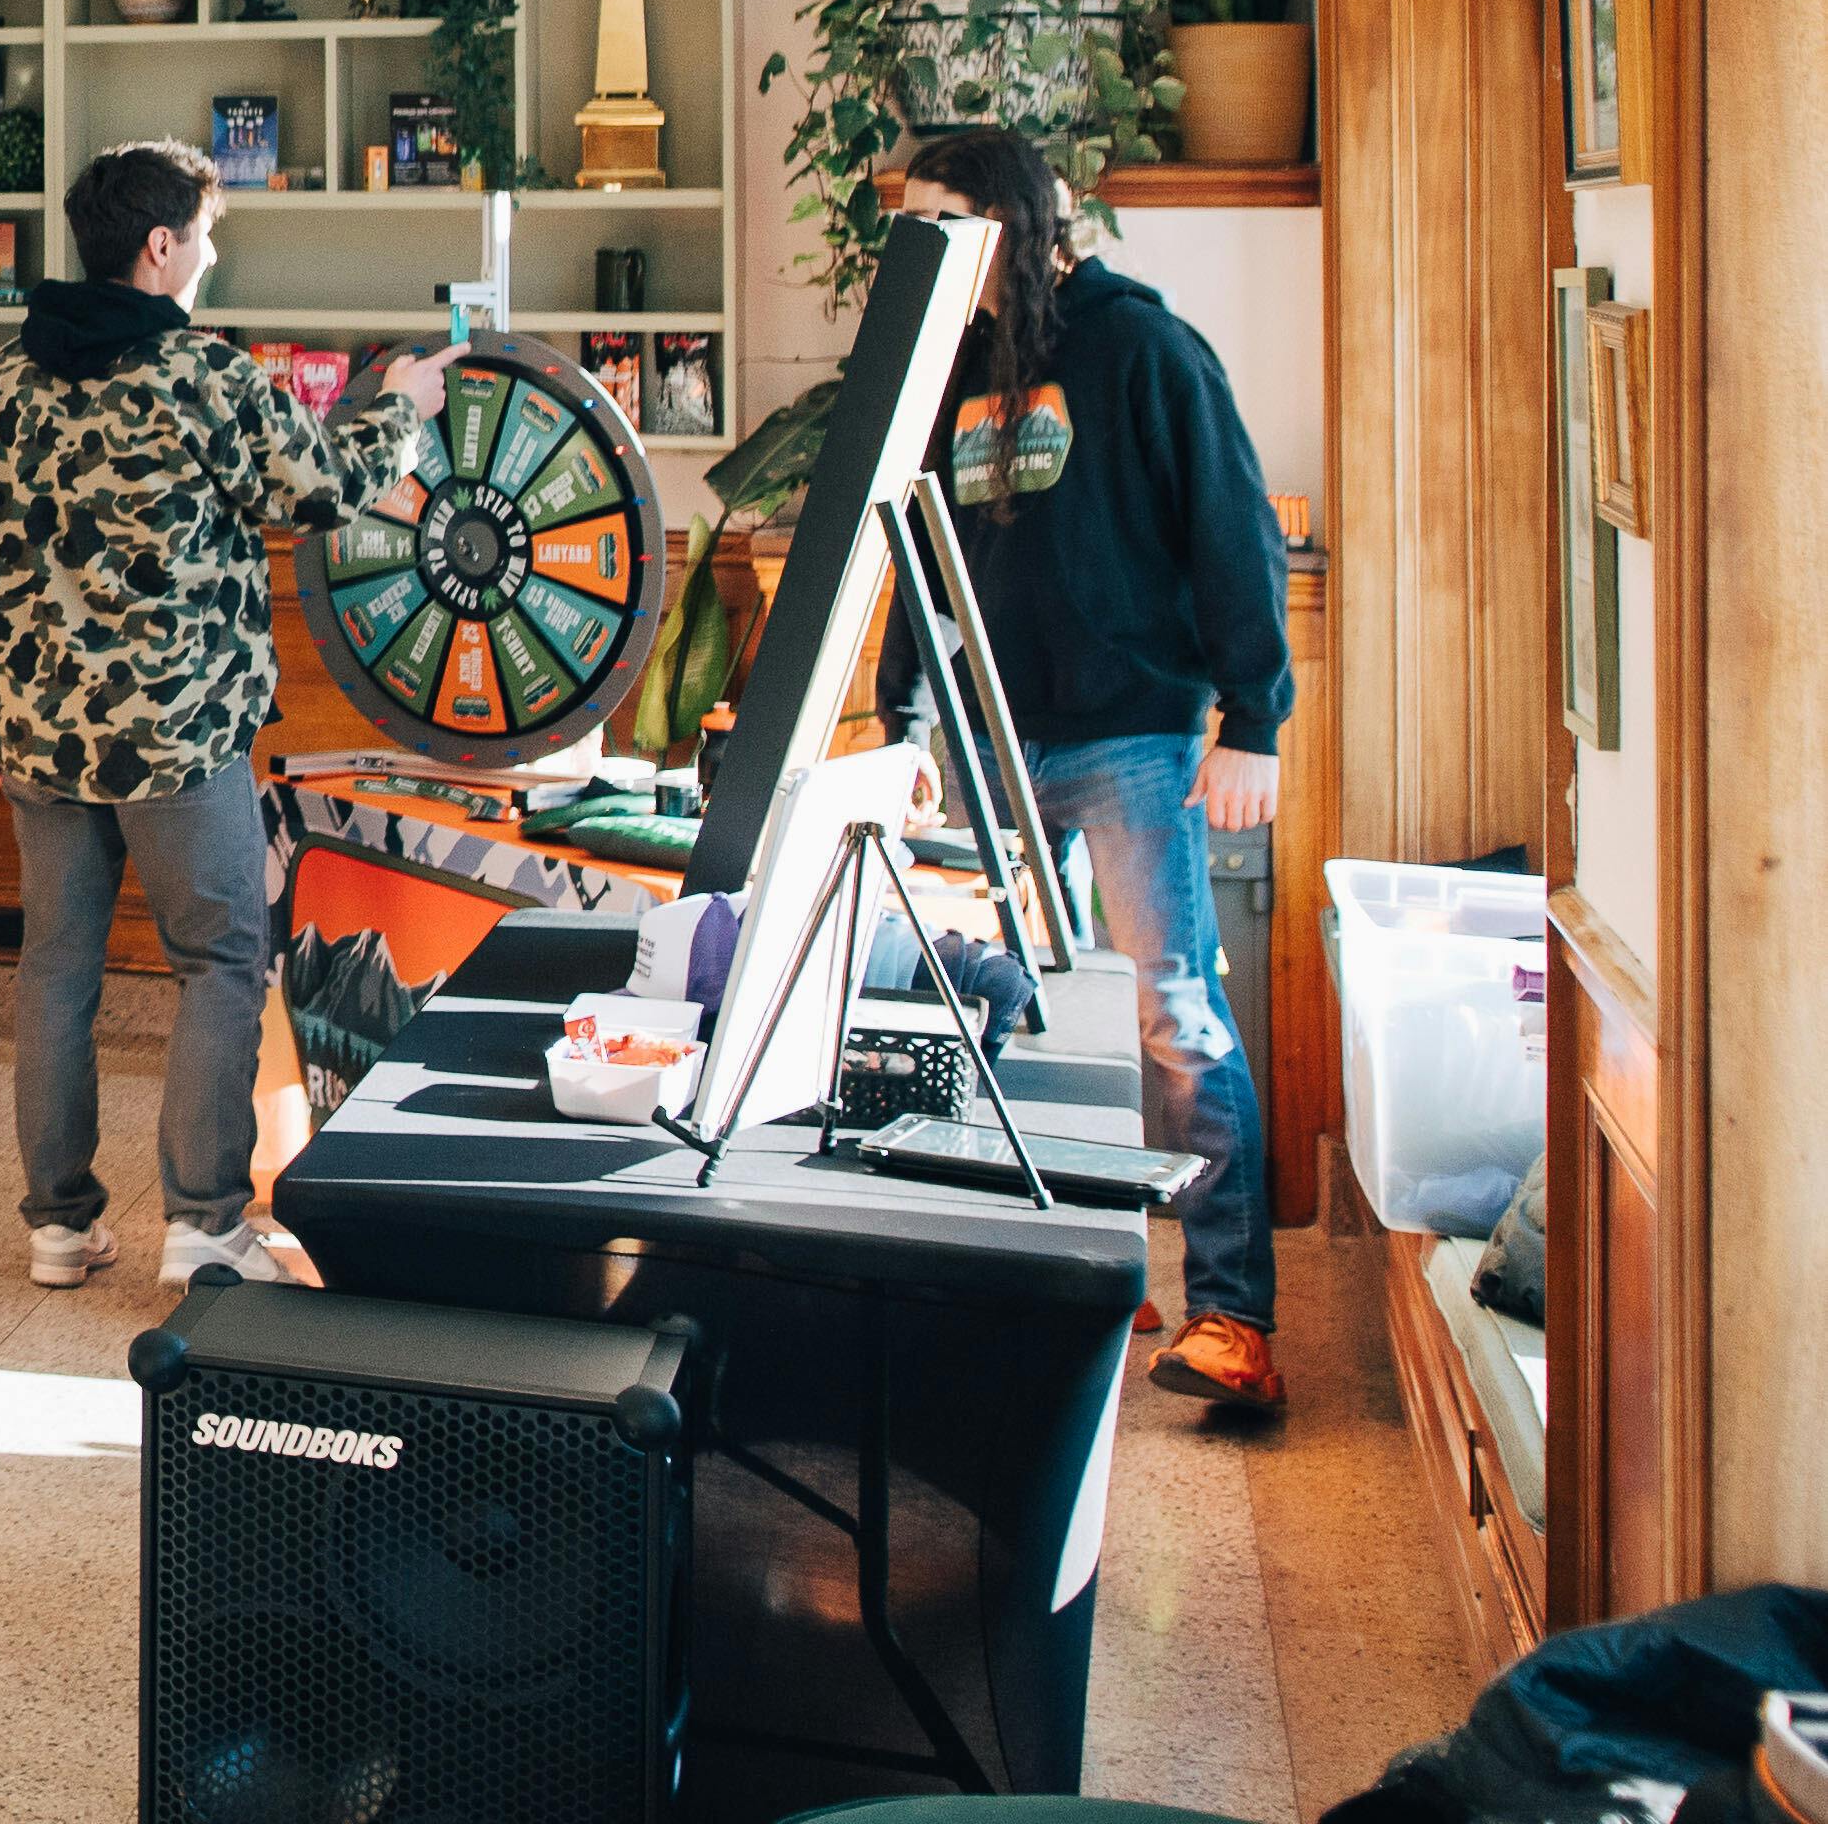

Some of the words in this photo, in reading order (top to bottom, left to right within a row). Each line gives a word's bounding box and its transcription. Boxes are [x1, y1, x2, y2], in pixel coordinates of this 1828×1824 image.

[474, 484, 514, 523] SPIN
[506, 519, 527, 548] TO
[537, 542, 593, 565] LANYARD
[440, 572, 479, 611] SPIN
[495, 615, 537, 678] T-SHIRT
[191, 1412, 404, 1470] SOUNDBOKS
